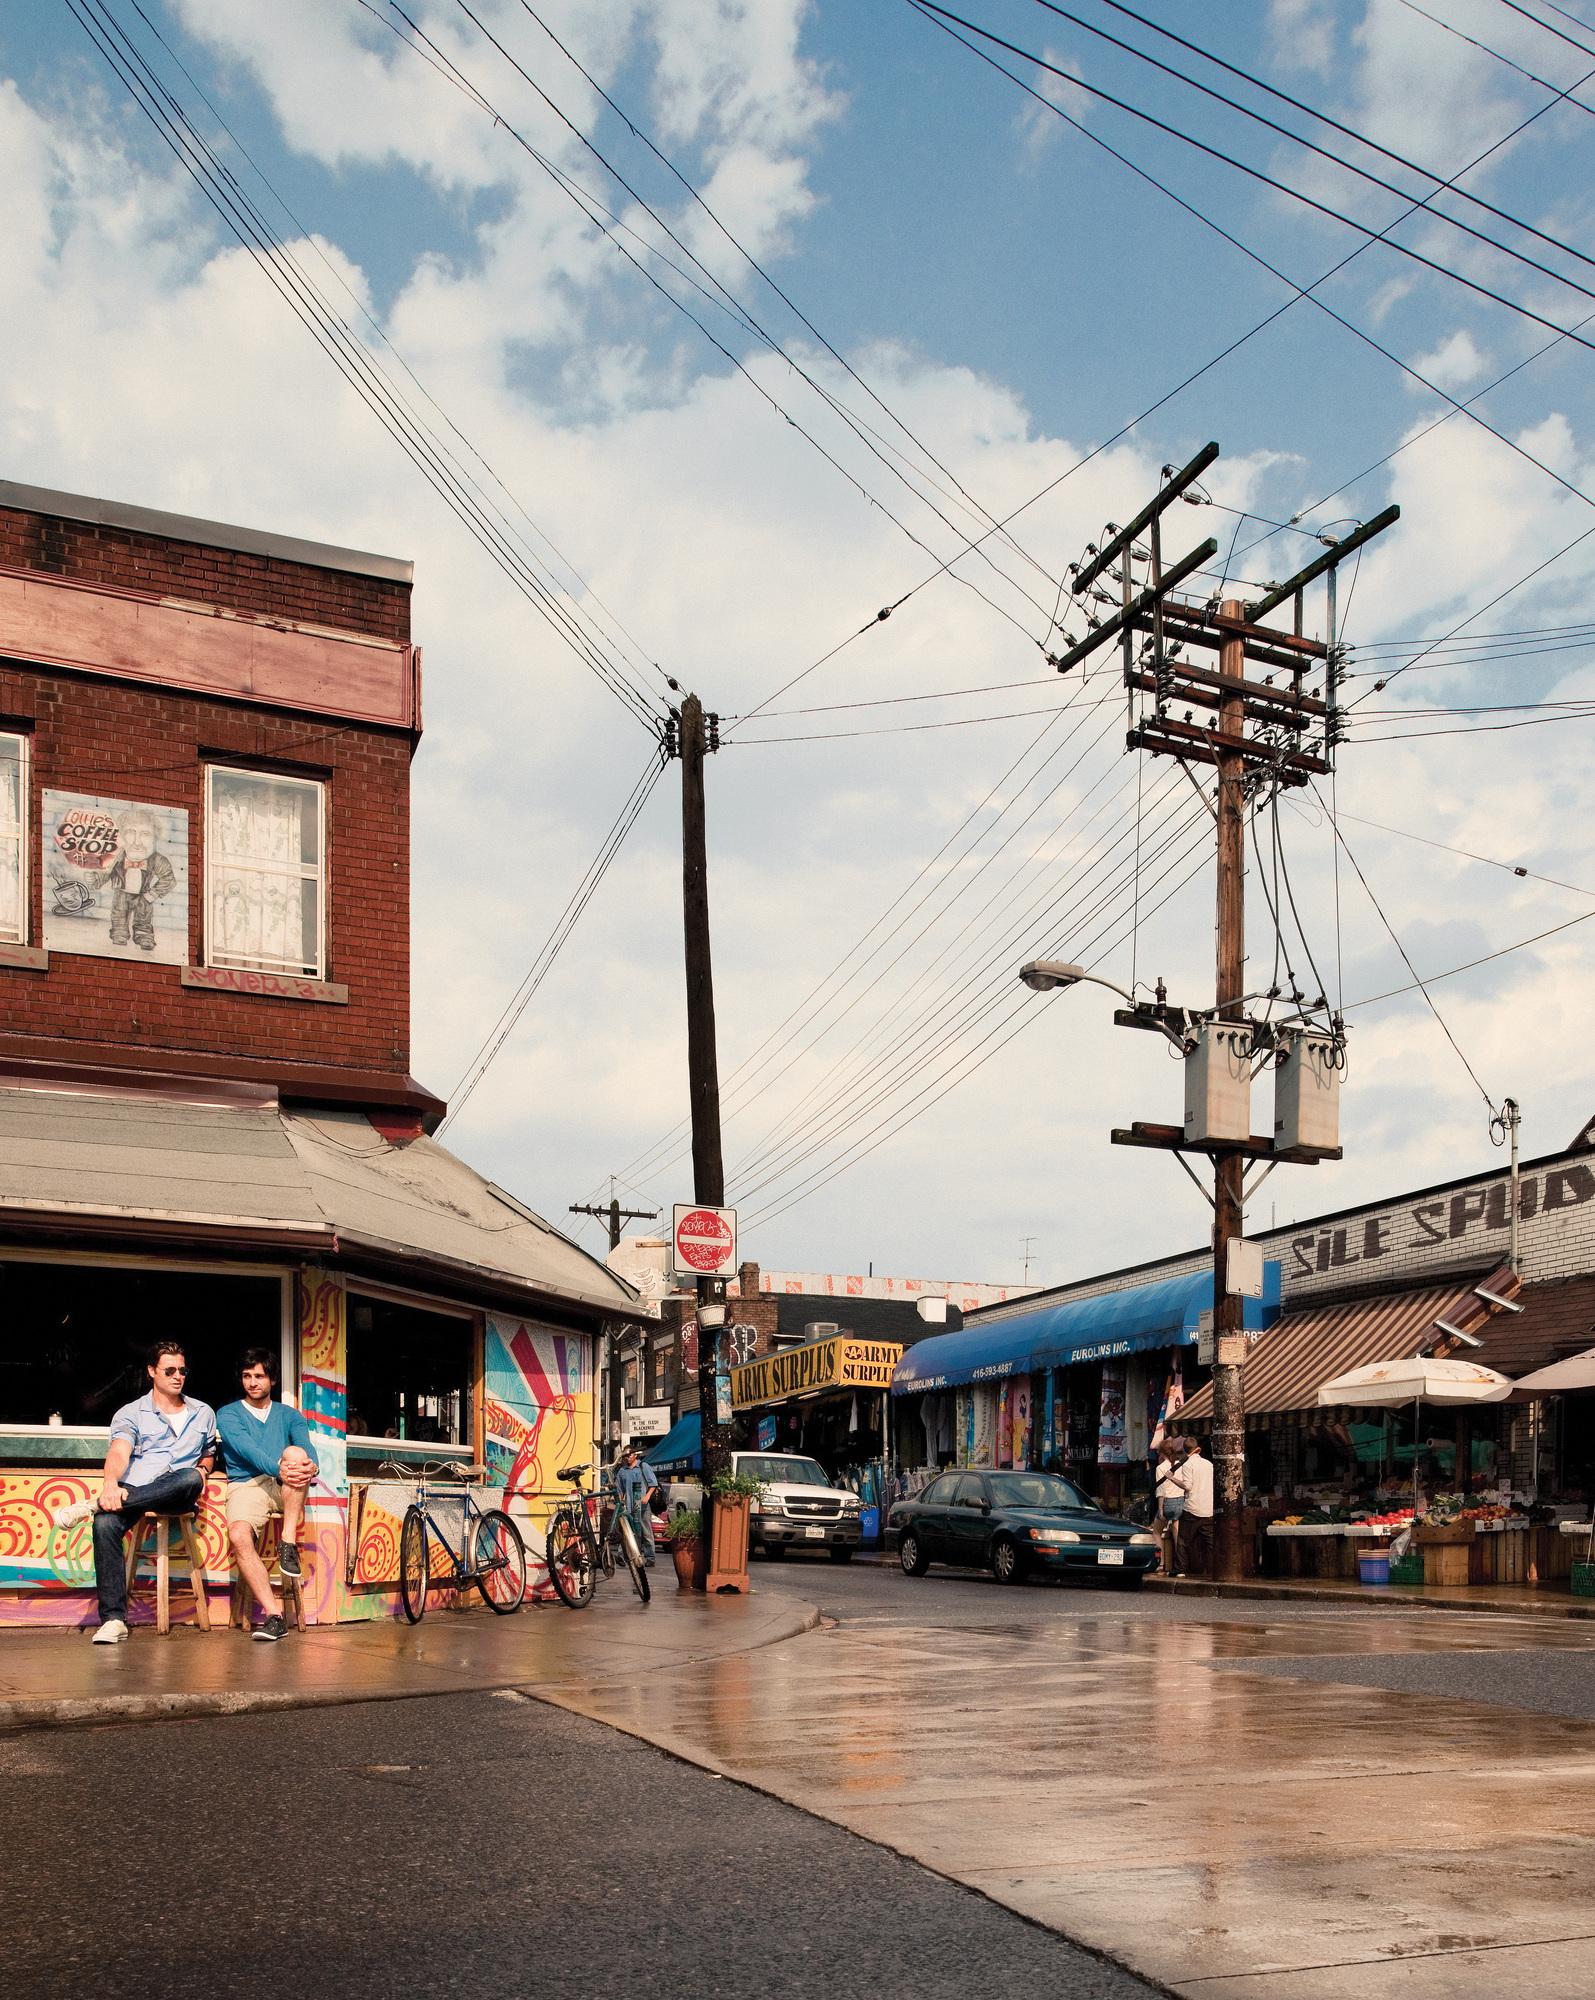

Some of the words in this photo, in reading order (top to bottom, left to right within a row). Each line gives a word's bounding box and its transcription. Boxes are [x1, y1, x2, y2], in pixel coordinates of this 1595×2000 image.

[57, 823, 119, 842] COFFEE
[60, 837, 119, 854] STOP
[862, 1345, 902, 1364] ARMY
[1072, 1344, 1111, 1361] EUROLINS
[1113, 1341, 1130, 1354] INC.
[737, 1362, 769, 1404] ARMY
[772, 1341, 837, 1395] SURPLUS
[842, 1364, 896, 1383] SURPLU
[972, 1362, 1013, 1379] 416-593-4887
[935, 1375, 947, 1387] INC.
